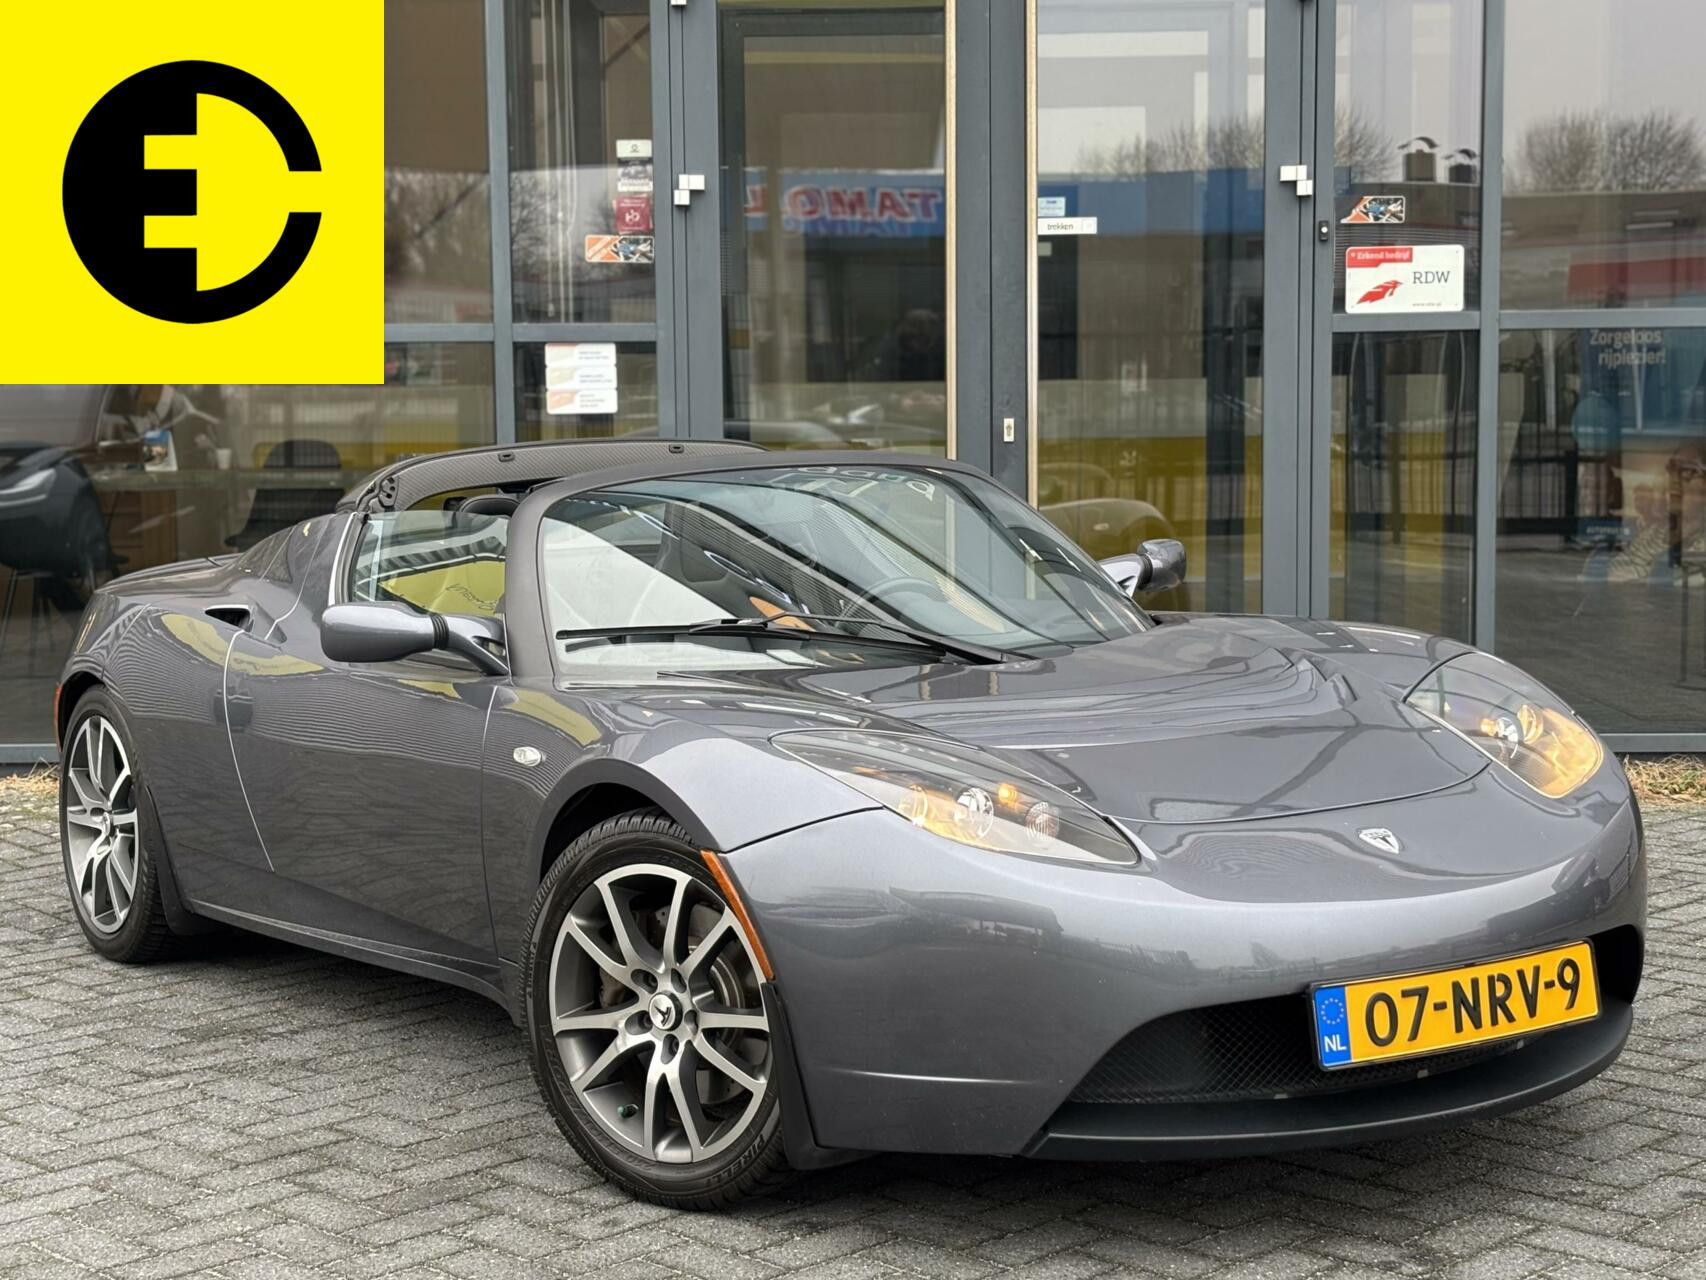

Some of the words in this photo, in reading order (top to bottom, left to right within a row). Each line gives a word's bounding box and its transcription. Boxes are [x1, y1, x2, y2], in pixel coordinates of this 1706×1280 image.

[1047, 222, 1074, 231] trekken
[1356, 252, 1384, 260] Erkend
[1385, 251, 1410, 260] bedrijf
[1412, 271, 1451, 285] RDW
[1589, 329, 1662, 349] Zorgeloos
[1598, 348, 1666, 369] rijplezier!
[1324, 1035, 1347, 1053] NL
[1365, 957, 1581, 1048] 07-NRV-9
